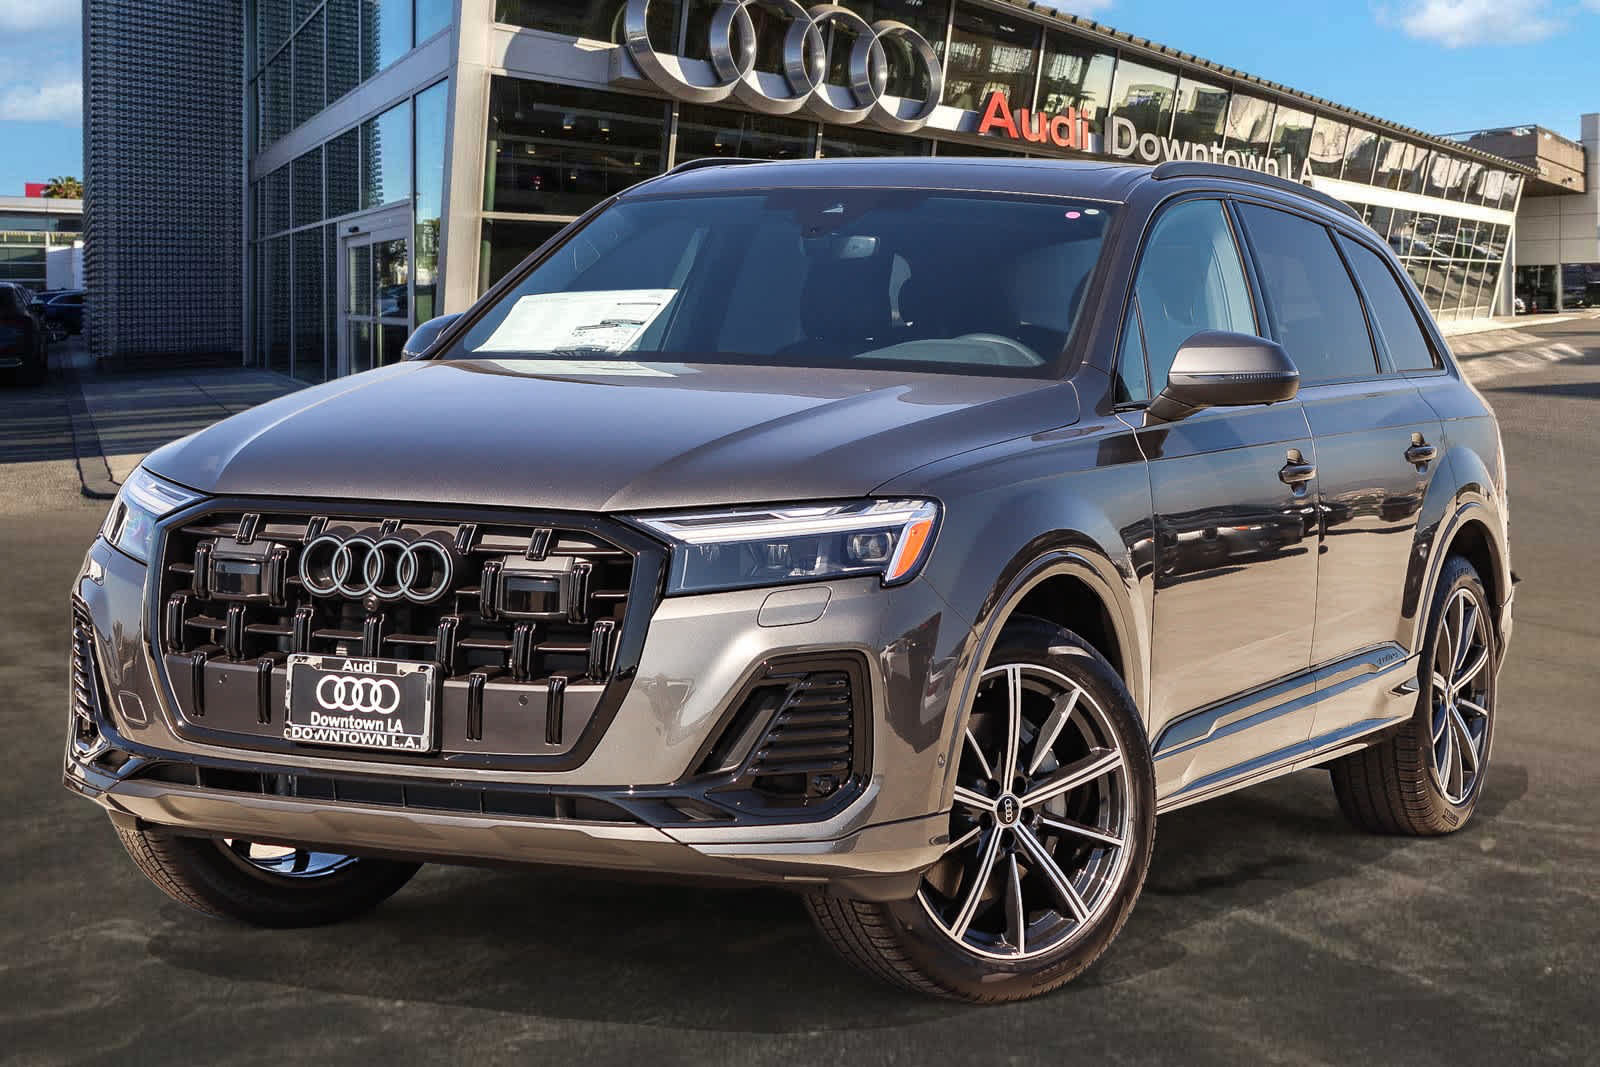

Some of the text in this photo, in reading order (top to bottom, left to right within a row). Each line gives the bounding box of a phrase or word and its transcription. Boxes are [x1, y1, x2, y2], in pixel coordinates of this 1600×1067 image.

[978, 90, 1314, 187] Audi Downtown LA
[342, 659, 377, 674] Audi
[310, 711, 404, 733] Downtown LA
[291, 726, 420, 749] DOWNTOWN L.A.
